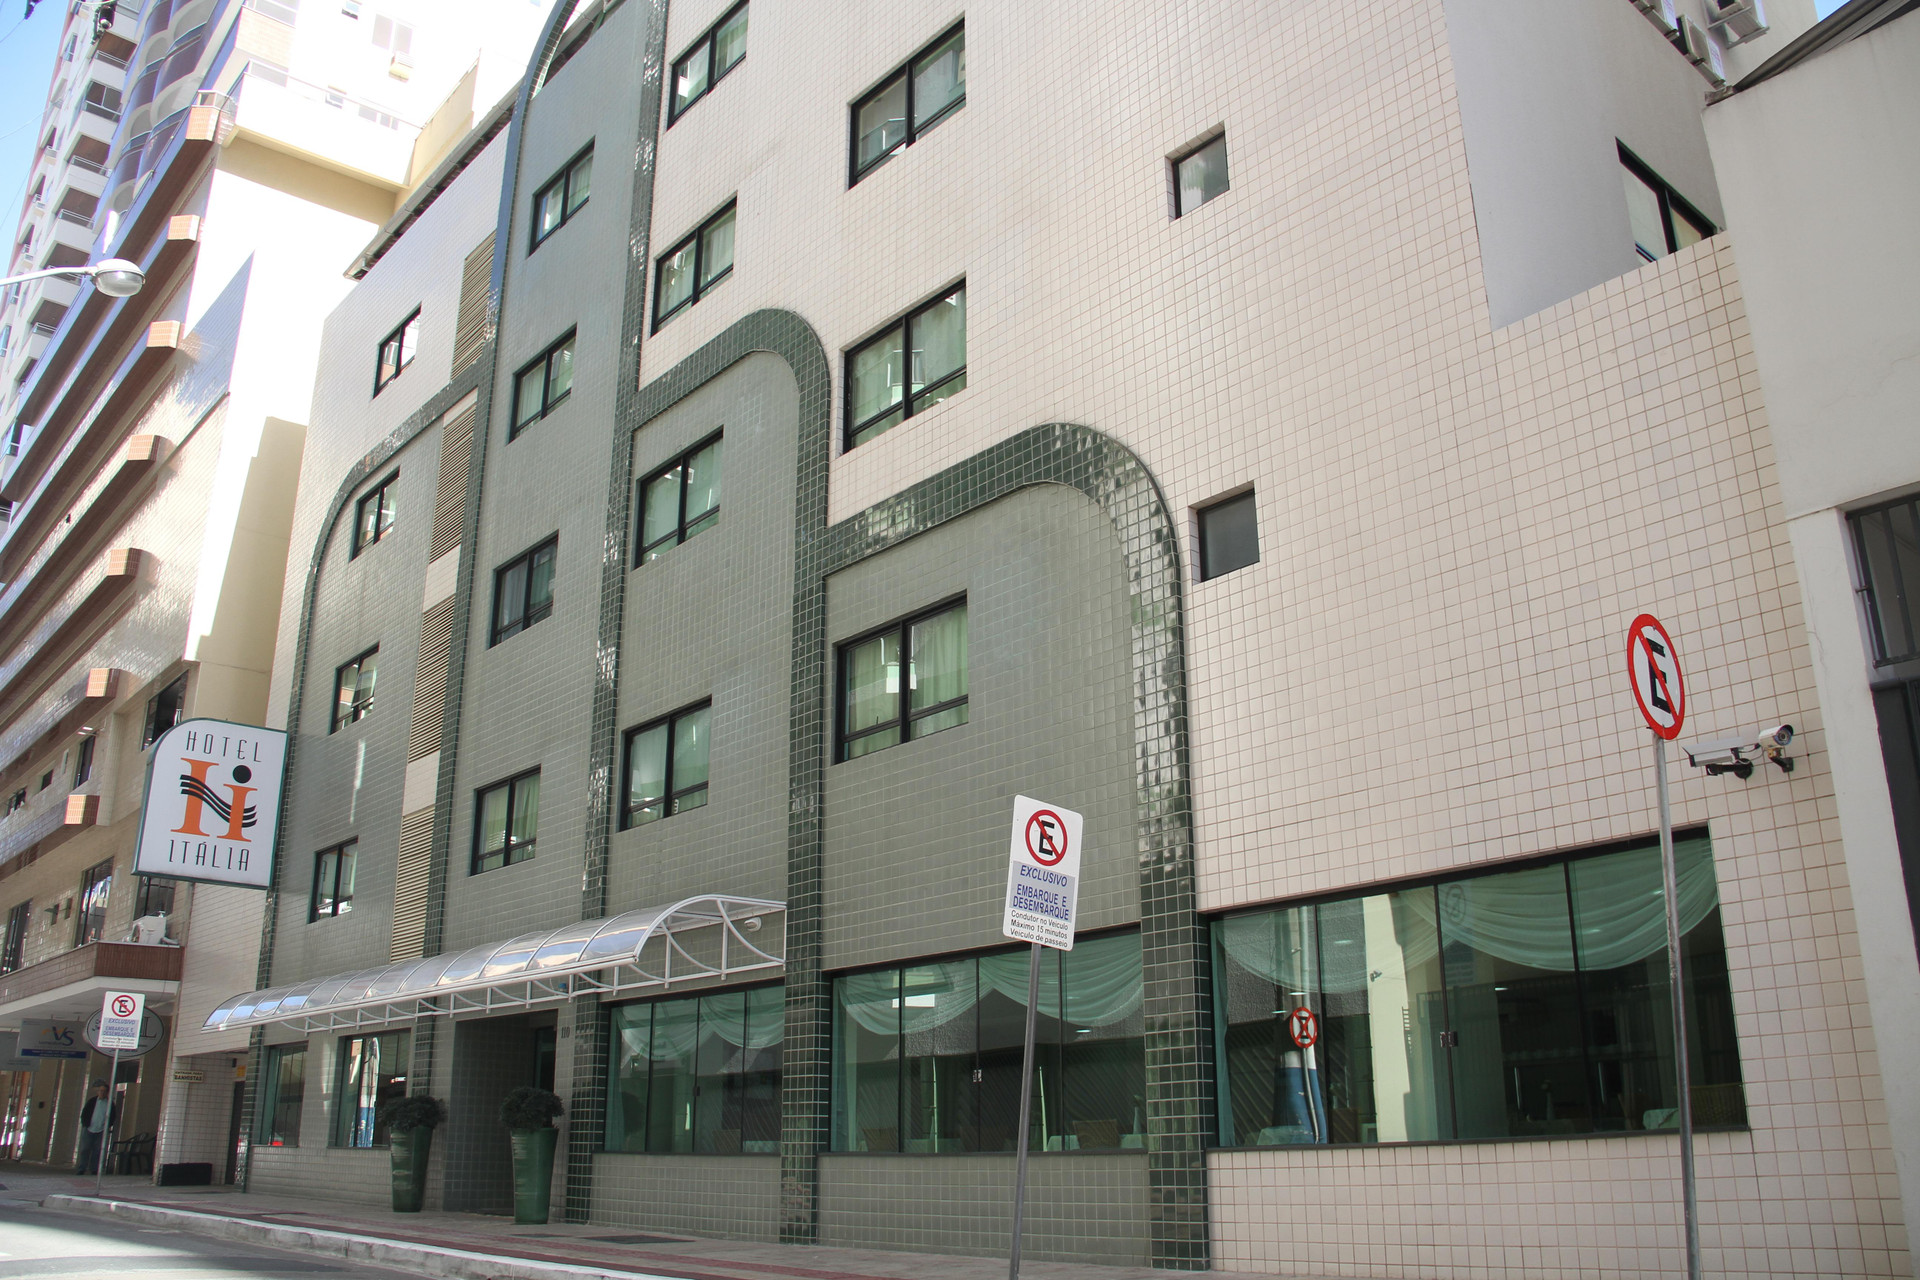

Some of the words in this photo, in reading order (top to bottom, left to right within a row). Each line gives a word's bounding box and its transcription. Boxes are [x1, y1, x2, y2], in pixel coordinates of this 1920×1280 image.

[186, 730, 262, 763] HOTEL
[168, 839, 250, 872] ITÁLIA
[1020, 864, 1068, 887] EXCLUSIVO
[1012, 895, 1069, 920] DESEMBARQUE
[1016, 883, 1059, 905] EMBARQUE
[1062, 896, 1067, 908] E
[1011, 909, 1039, 923] Condutor
[1035, 934, 1043, 942] de
[1044, 937, 1068, 948] passeio
[1037, 925, 1044, 933] 15
[1044, 928, 1068, 939] minutos
